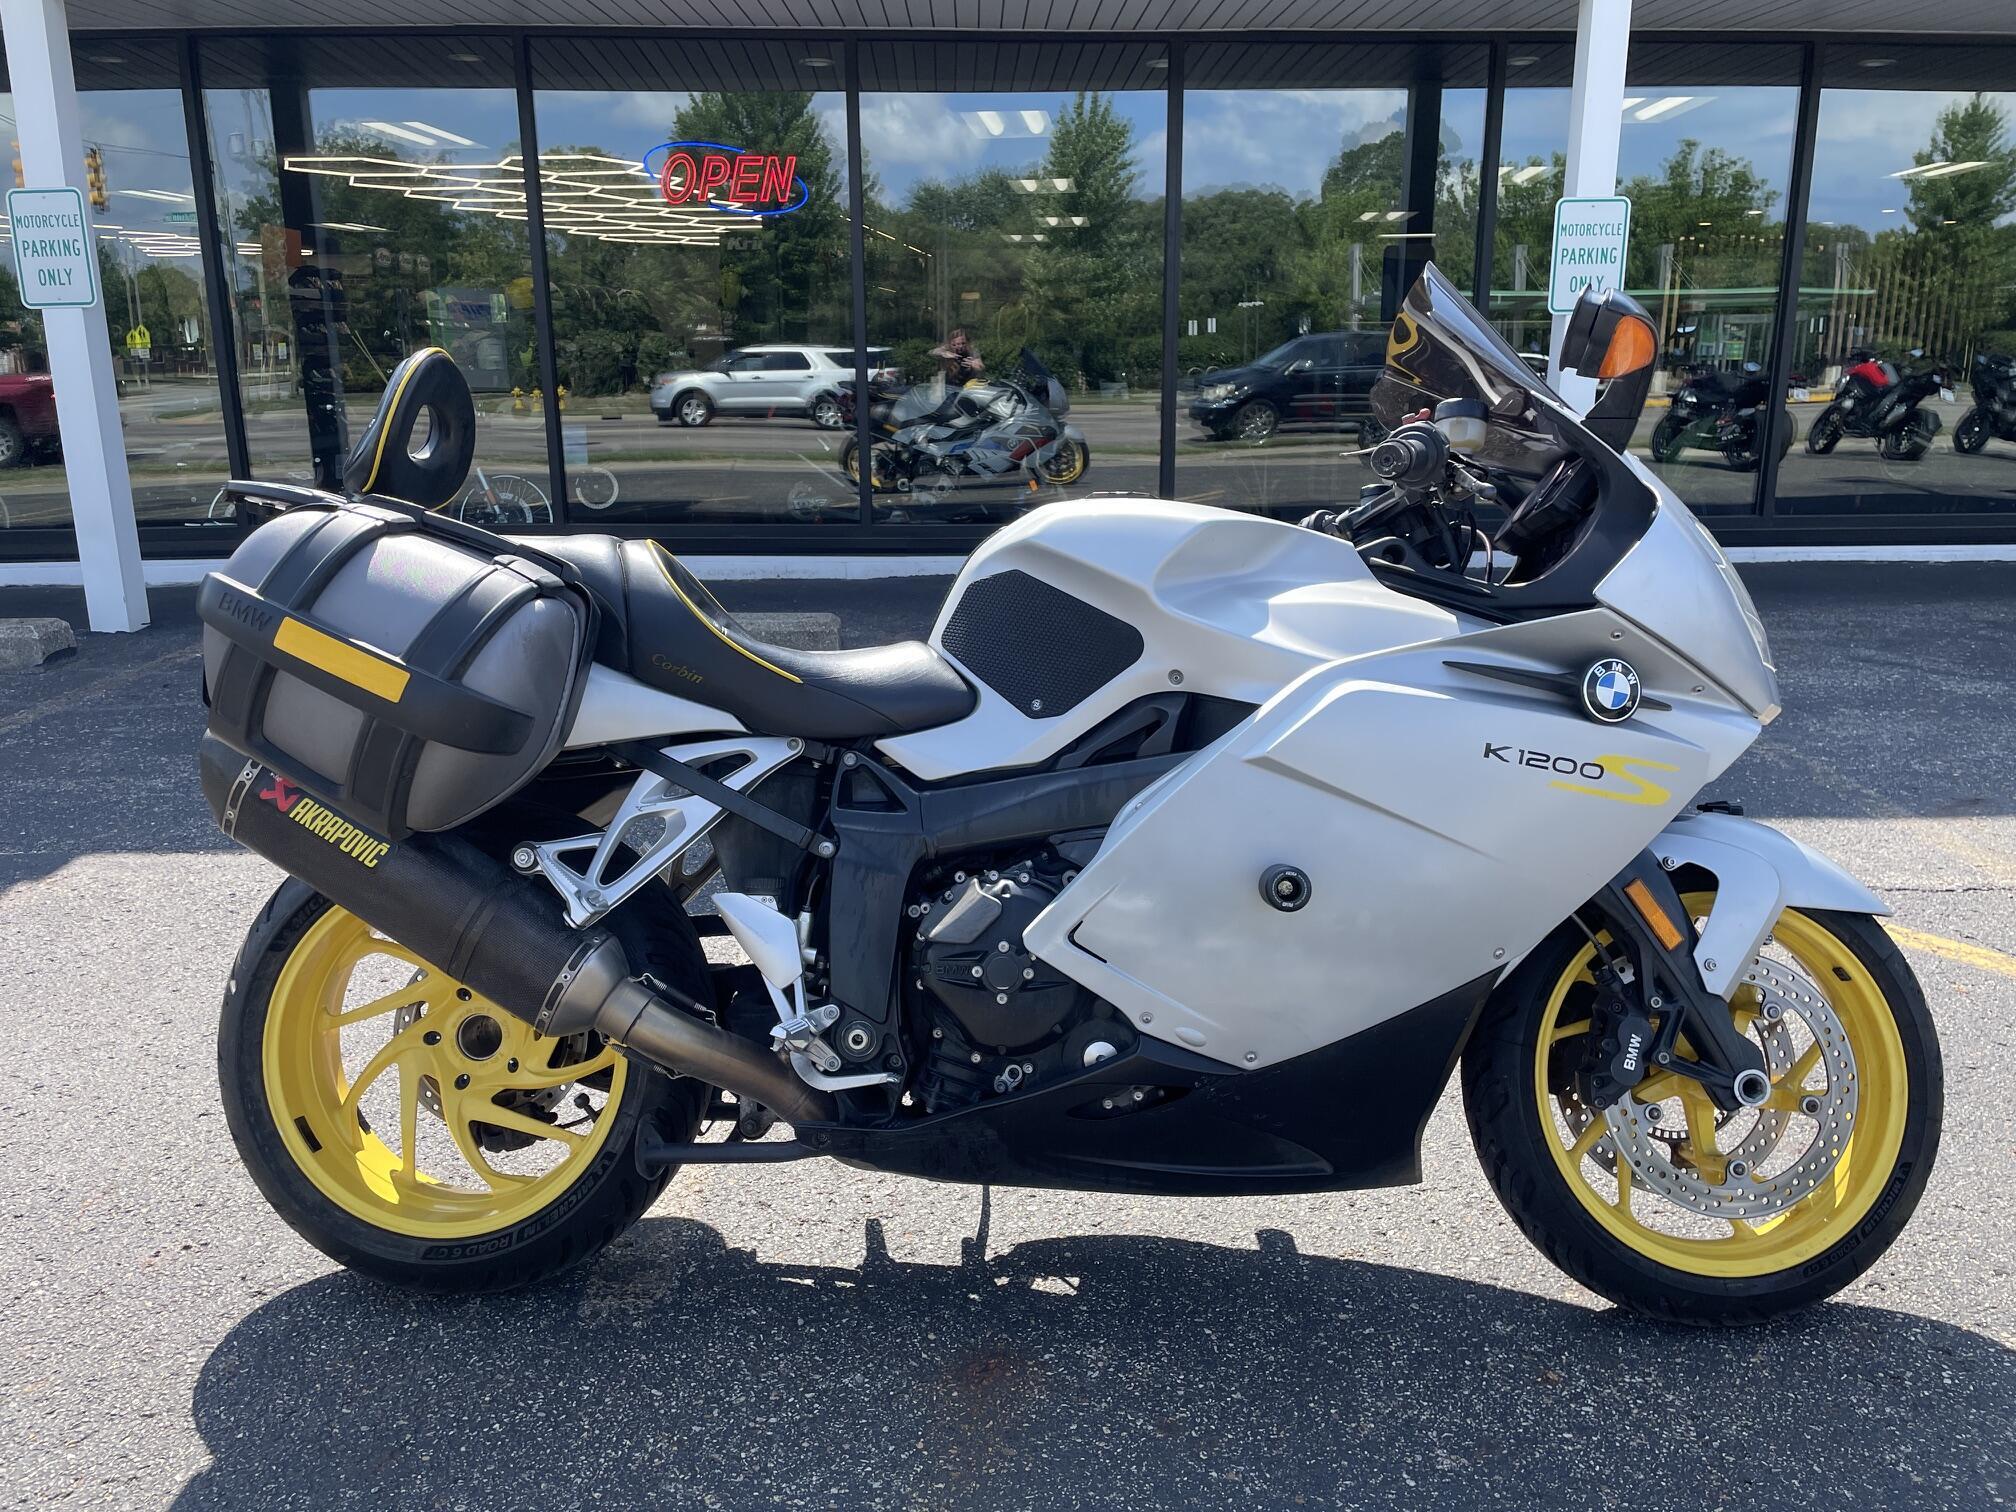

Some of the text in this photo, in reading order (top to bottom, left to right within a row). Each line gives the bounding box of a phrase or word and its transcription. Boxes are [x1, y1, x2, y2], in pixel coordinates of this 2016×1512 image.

[660, 152, 797, 205] OPEN
[14, 214, 80, 229] MOTORCYCLE
[1560, 223, 1623, 237] MOTORCYCLE
[22, 239, 81, 258] PARKING
[1560, 247, 1618, 265] PARKING
[38, 268, 72, 287] ONLY
[218, 591, 273, 632] BMW
[651, 653, 704, 684] Corbin
[1593, 661, 1638, 686] BMW
[1623, 1033, 1642, 1071] BMW
[523, 1174, 596, 1239] MICHELIN
[1863, 1180, 1902, 1235] MICHELIN
[452, 1247, 463, 1258] 6
[464, 1235, 510, 1257] ROAD
[1829, 1237, 1858, 1263] ROAD
